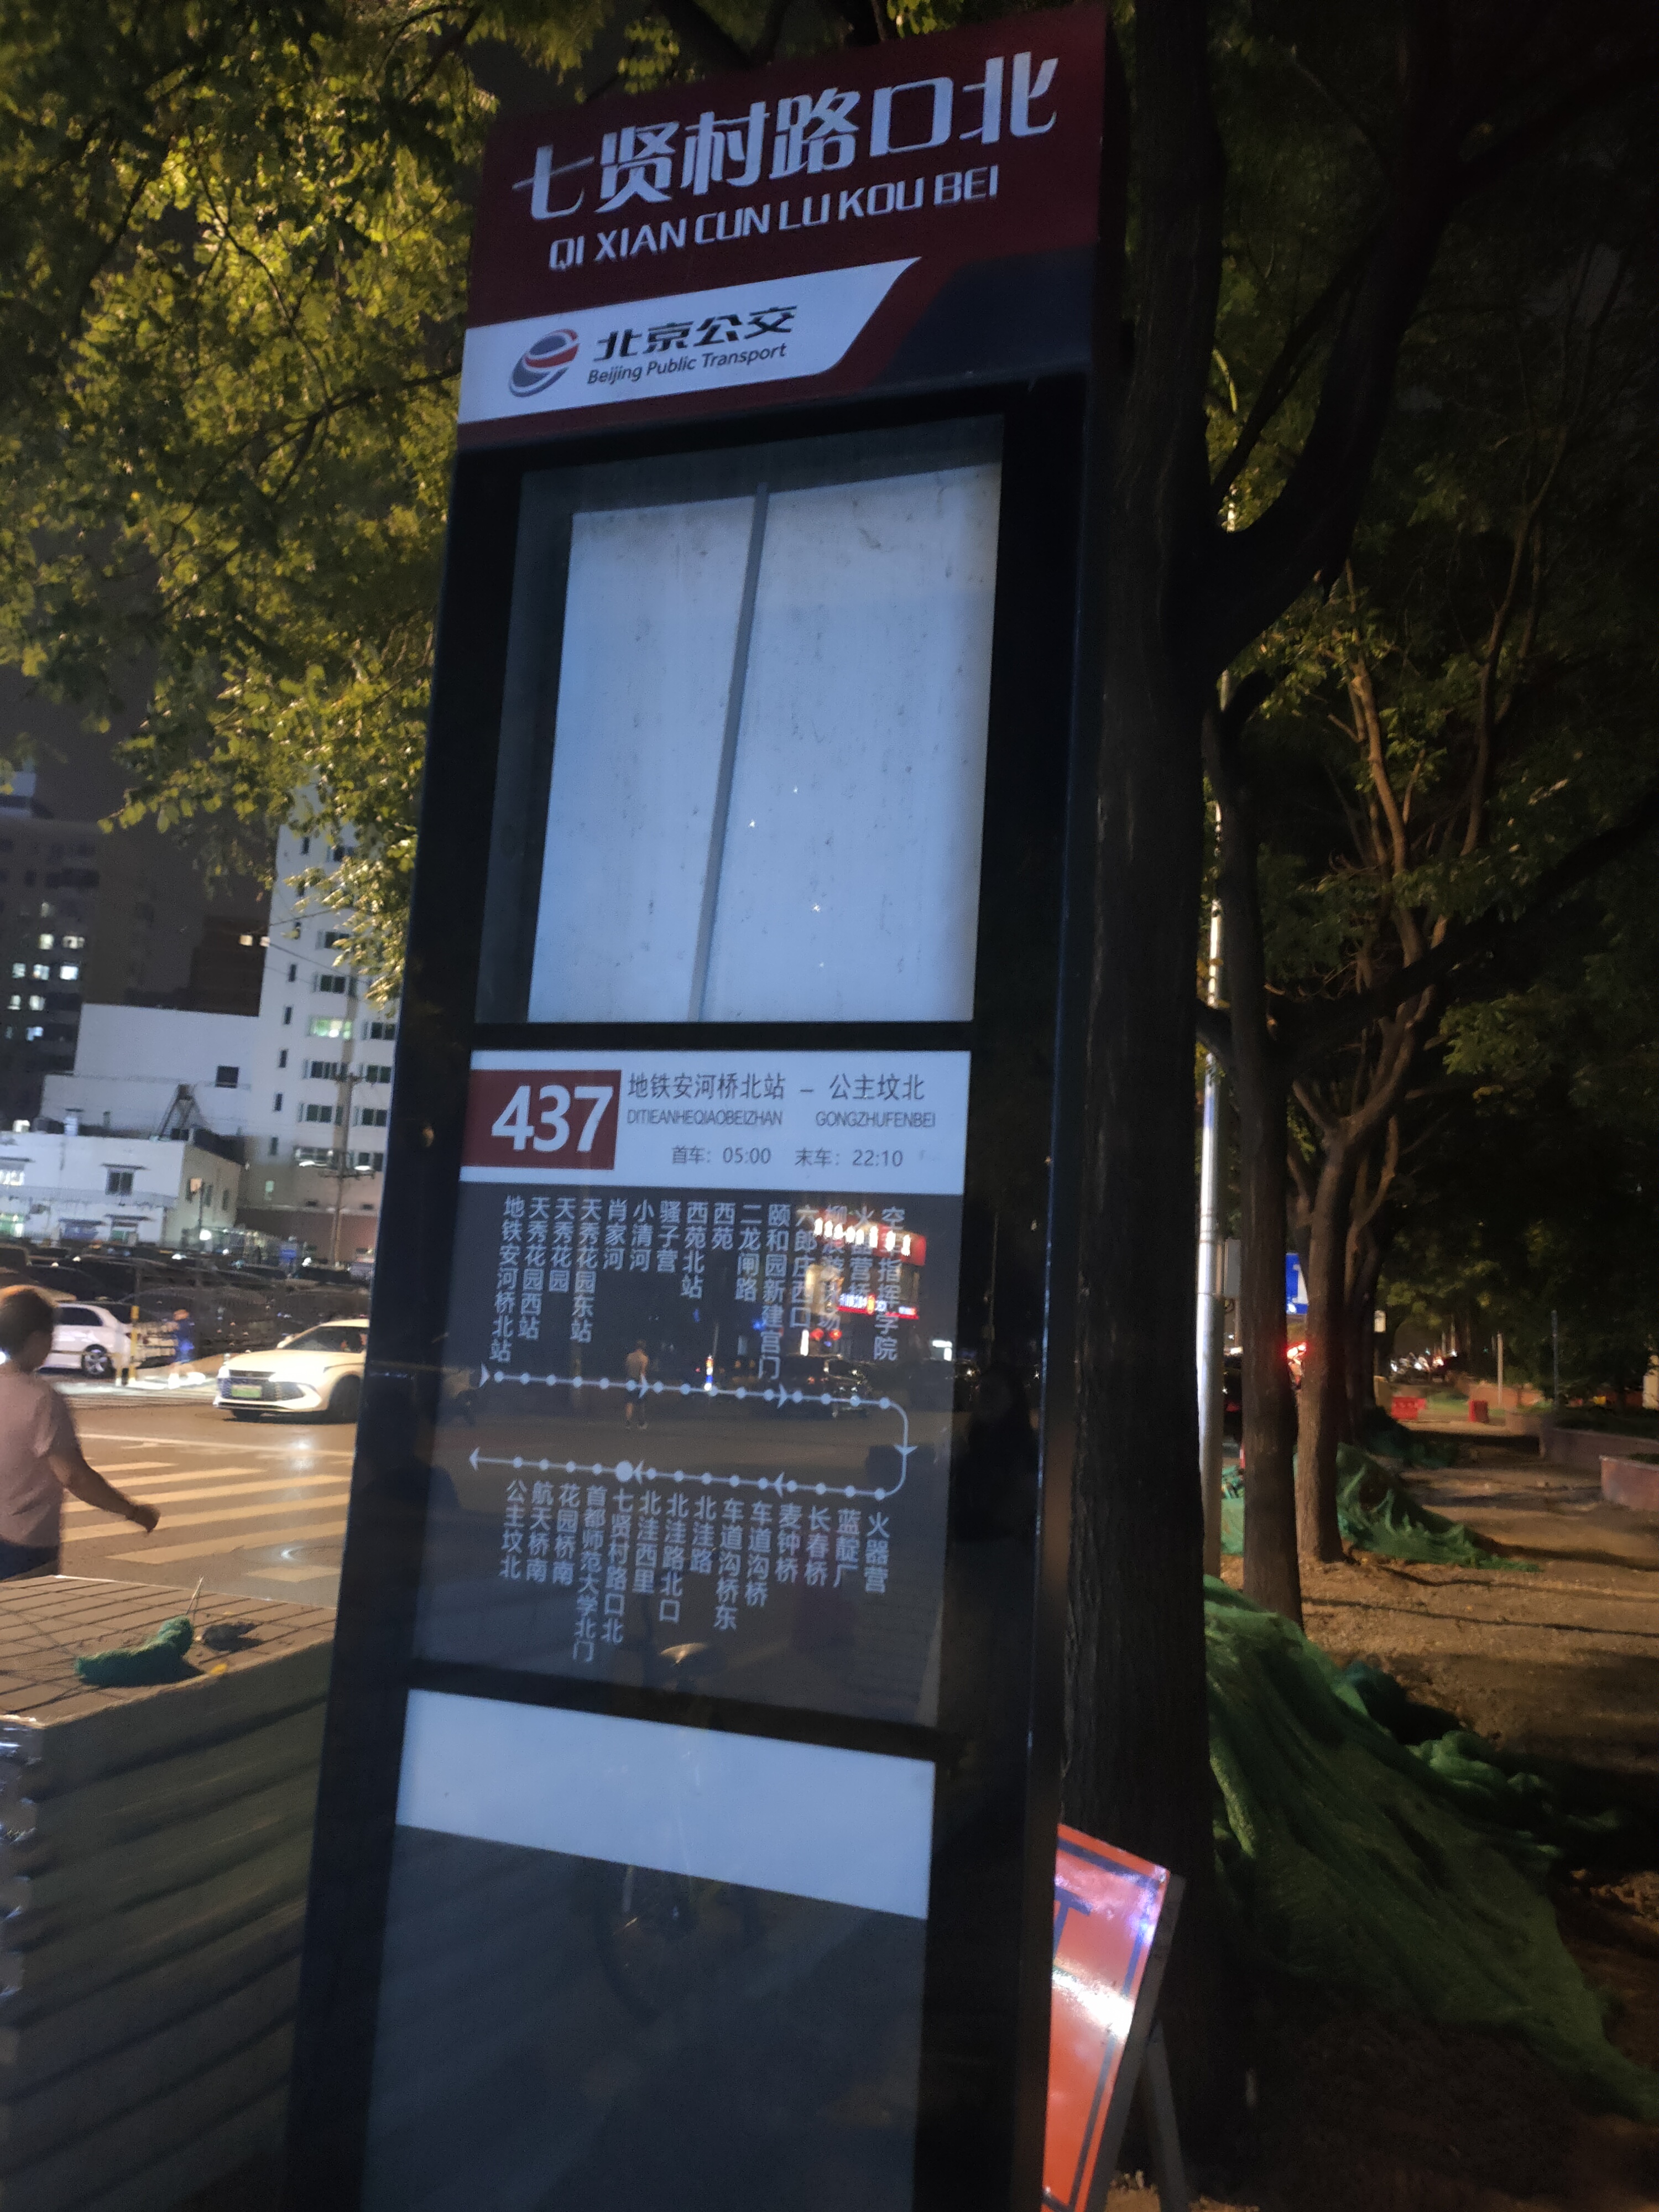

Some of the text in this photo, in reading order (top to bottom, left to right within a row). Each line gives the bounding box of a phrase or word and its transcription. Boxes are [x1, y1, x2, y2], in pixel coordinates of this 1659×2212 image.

[513, 51, 1058, 220] 七贤村路口北
[549, 165, 998, 271] QI XIAN CUN LU KOU BEI
[587, 342, 787, 385] Beijing Public Transport
[593, 306, 797, 362] 北京公交
[490, 1084, 614, 1153] 437
[628, 1072, 786, 1100] 地铁安河桥北站
[829, 1073, 925, 1102] 公主坟北
[816, 1110, 936, 1128] GONGZHUFENBEI
[722, 1146, 771, 1165] 05:00
[852, 1149, 904, 1167] 22:10
[518, 1196, 551, 1340] 天秀花园西站
[549, 1197, 576, 1292] 天秀花园
[570, 1198, 602, 1343] 天秀花园东站
[603, 1198, 628, 1271] 肖家河
[629, 1199, 654, 1272] 小清河
[656, 1200, 681, 1272] 骚子营
[680, 1201, 708, 1300] 西苑北站
[712, 1202, 736, 1251] 西苑
[735, 1204, 762, 1302] 二龙闸路
[489, 1195, 525, 1363] 地铁安河桥北站
[758, 1204, 790, 1380] 颐和园新建宫门
[498, 1480, 526, 1579] 公主坟北
[526, 1480, 554, 1583] 航天桥南
[552, 1483, 580, 1586] 花园桥南
[573, 1485, 608, 1663] 首都师范大学北门
[601, 1488, 634, 1646] 七贤村路口北
[632, 1490, 661, 1594] 北洼西里
[659, 1493, 689, 1624] 北洼路北口
[690, 1495, 717, 1575] 北洼路
[713, 1498, 744, 1631] 车道沟桥东
[744, 1500, 773, 1608] 车道沟桥
[775, 1503, 802, 1583] 麦钟桥
[804, 1505, 831, 1587] 长春桥
[833, 1509, 861, 1588] 蓝靛厂
[864, 1511, 890, 1594] 火器营
